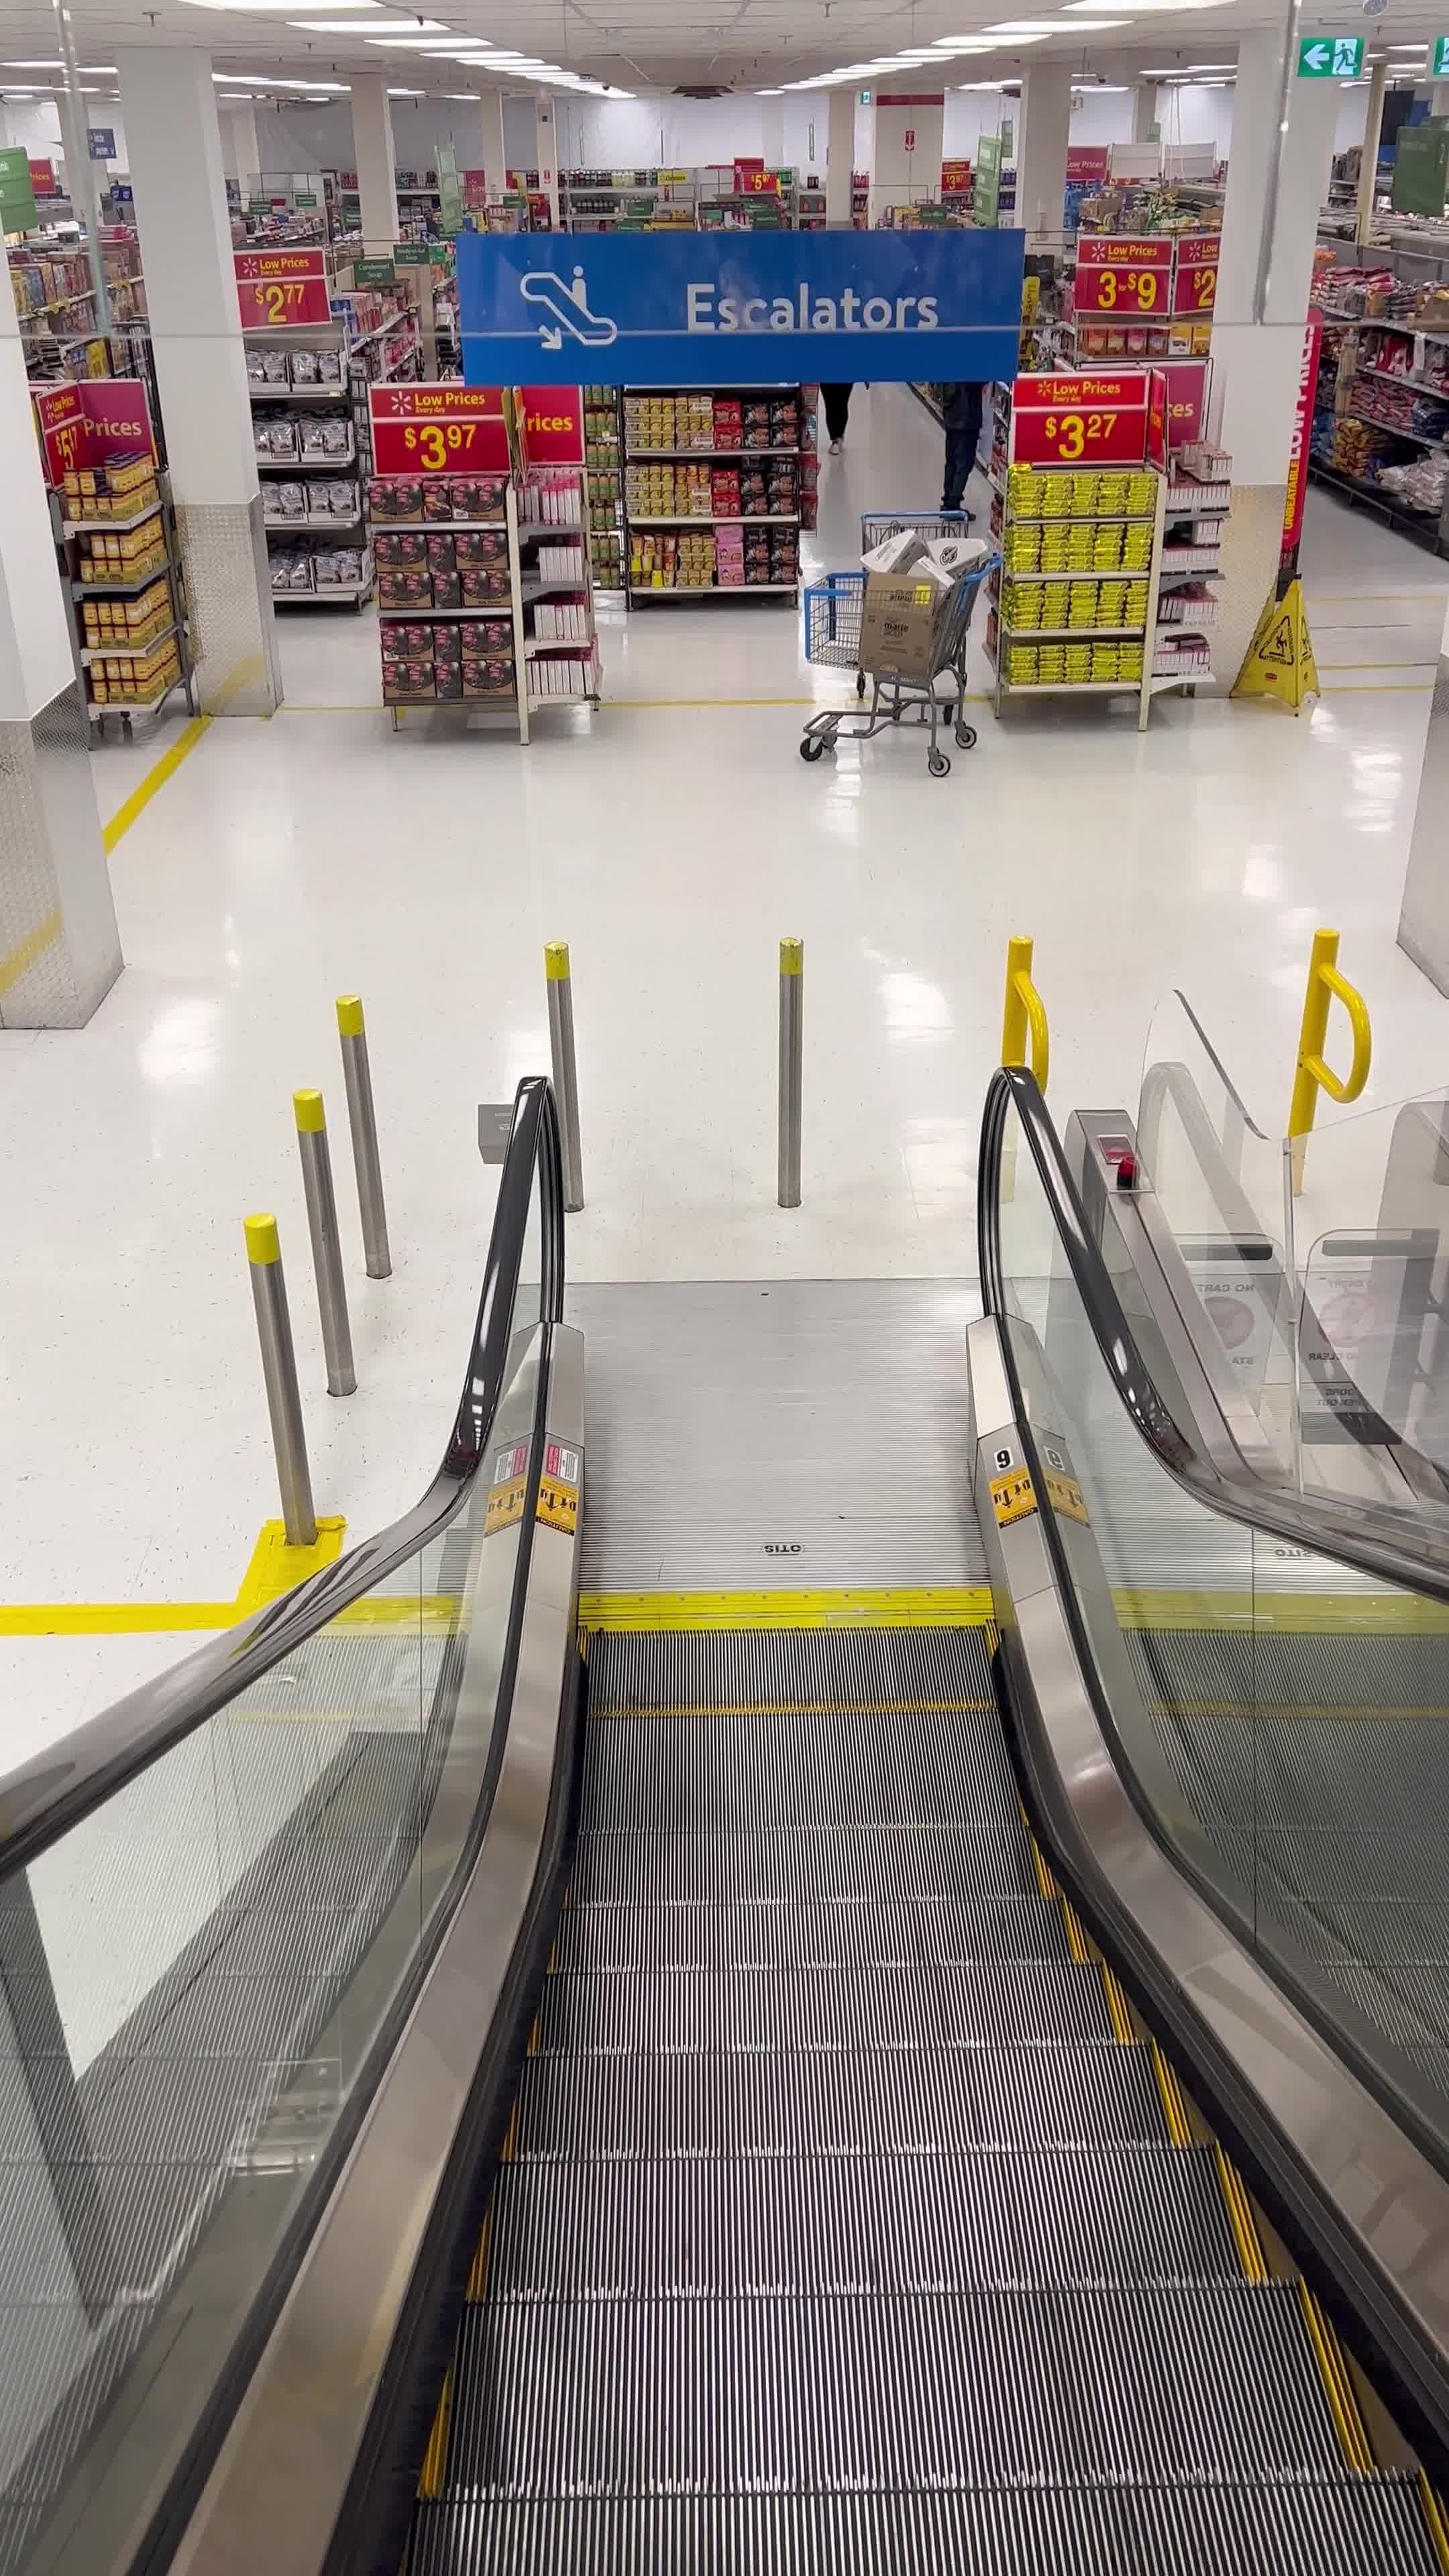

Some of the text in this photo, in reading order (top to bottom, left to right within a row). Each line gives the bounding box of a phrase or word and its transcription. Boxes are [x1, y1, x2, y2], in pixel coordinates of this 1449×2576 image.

[1108, 244, 1158, 256] Low Prices
[1202, 243, 1218, 254] Low
[259, 257, 310, 270] Low Prices
[1097, 271, 1116, 308] 3
[687, 282, 938, 333] Escalators
[1053, 380, 1121, 396] Low Prices
[415, 391, 486, 407] Low Prices
[415, 407, 433, 415] Every
[84, 417, 142, 437] Prices
[526, 413, 574, 431] rices
[1283, 461, 1299, 529] UNBEATABLE
